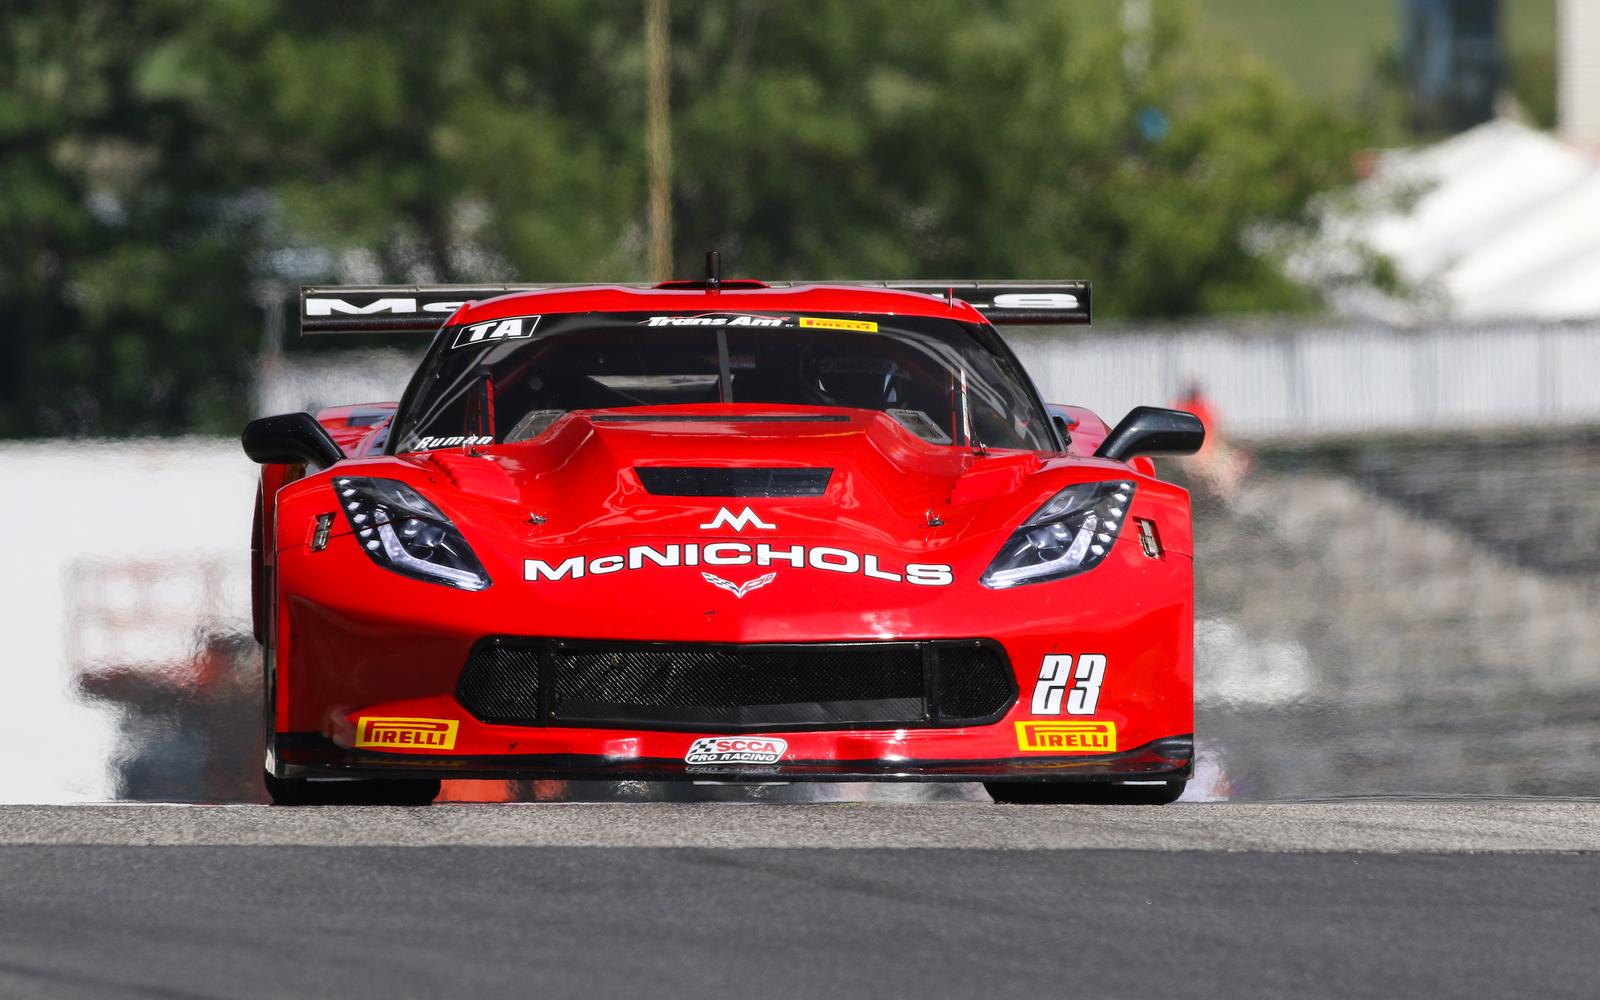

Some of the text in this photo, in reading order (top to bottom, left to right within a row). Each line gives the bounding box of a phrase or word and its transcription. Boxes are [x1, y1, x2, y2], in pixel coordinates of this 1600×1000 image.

[468, 319, 523, 342] TA
[647, 316, 728, 327] Trans
[727, 316, 783, 327] Am
[1031, 652, 1108, 716] 23
[362, 719, 450, 746] PIRELLI
[1023, 724, 1109, 748] PIRELLI
[689, 753, 776, 762] PRO RACING
[716, 740, 777, 753] SCCA
